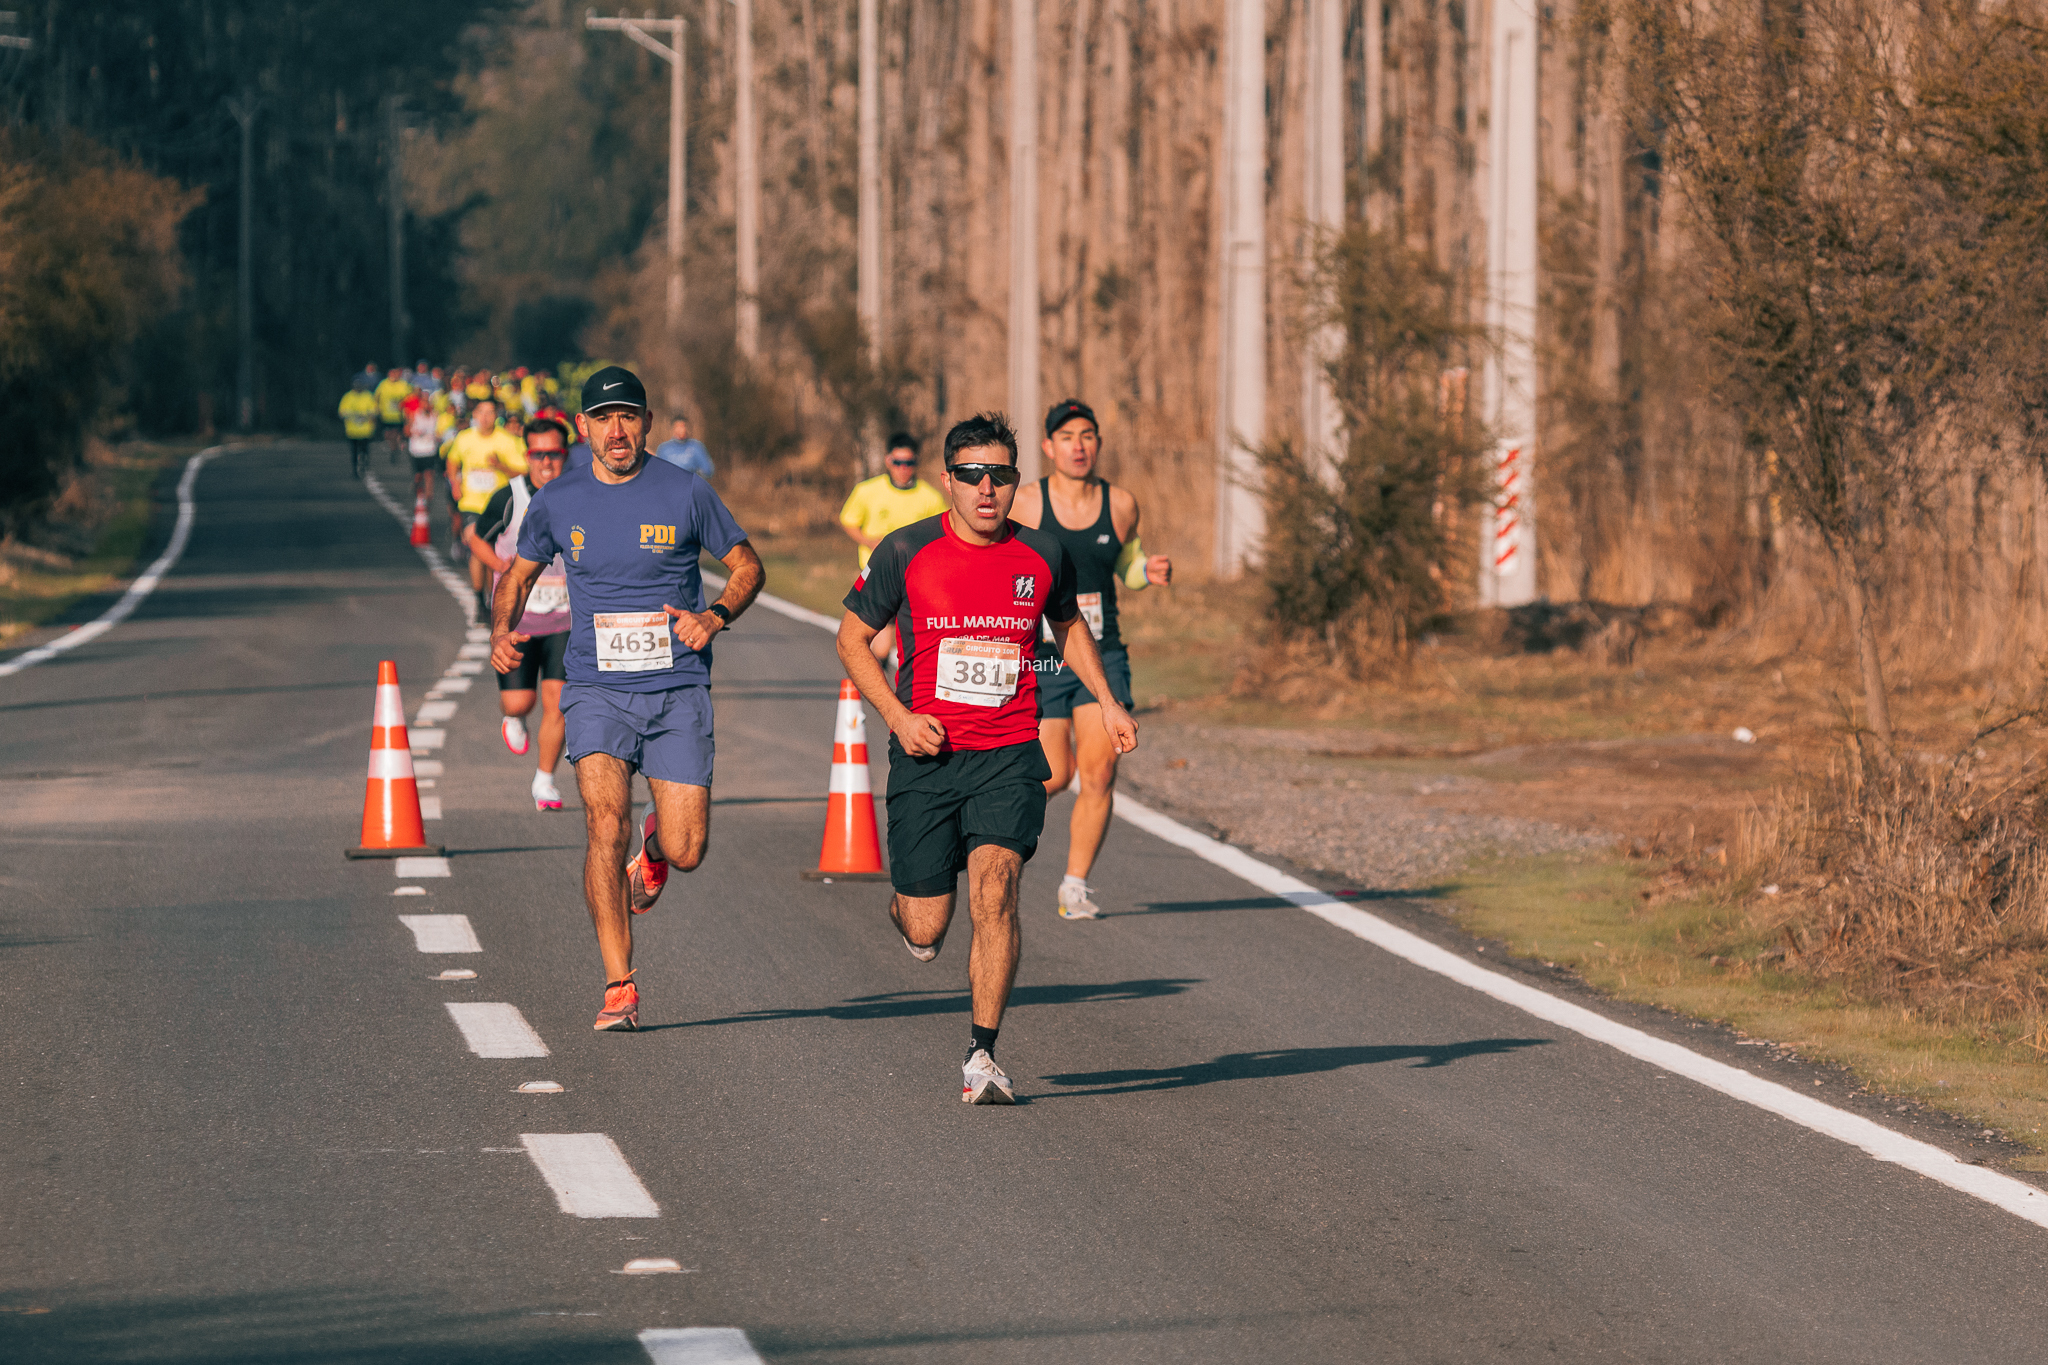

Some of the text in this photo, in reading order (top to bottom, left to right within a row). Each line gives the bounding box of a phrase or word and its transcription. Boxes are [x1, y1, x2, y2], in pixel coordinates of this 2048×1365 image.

[640, 524, 676, 544] PDI
[926, 616, 1035, 630] FULL MARATHON
[610, 632, 656, 653] 463
[966, 645, 1000, 653] CIRCUITO
[953, 661, 1003, 687] 381
